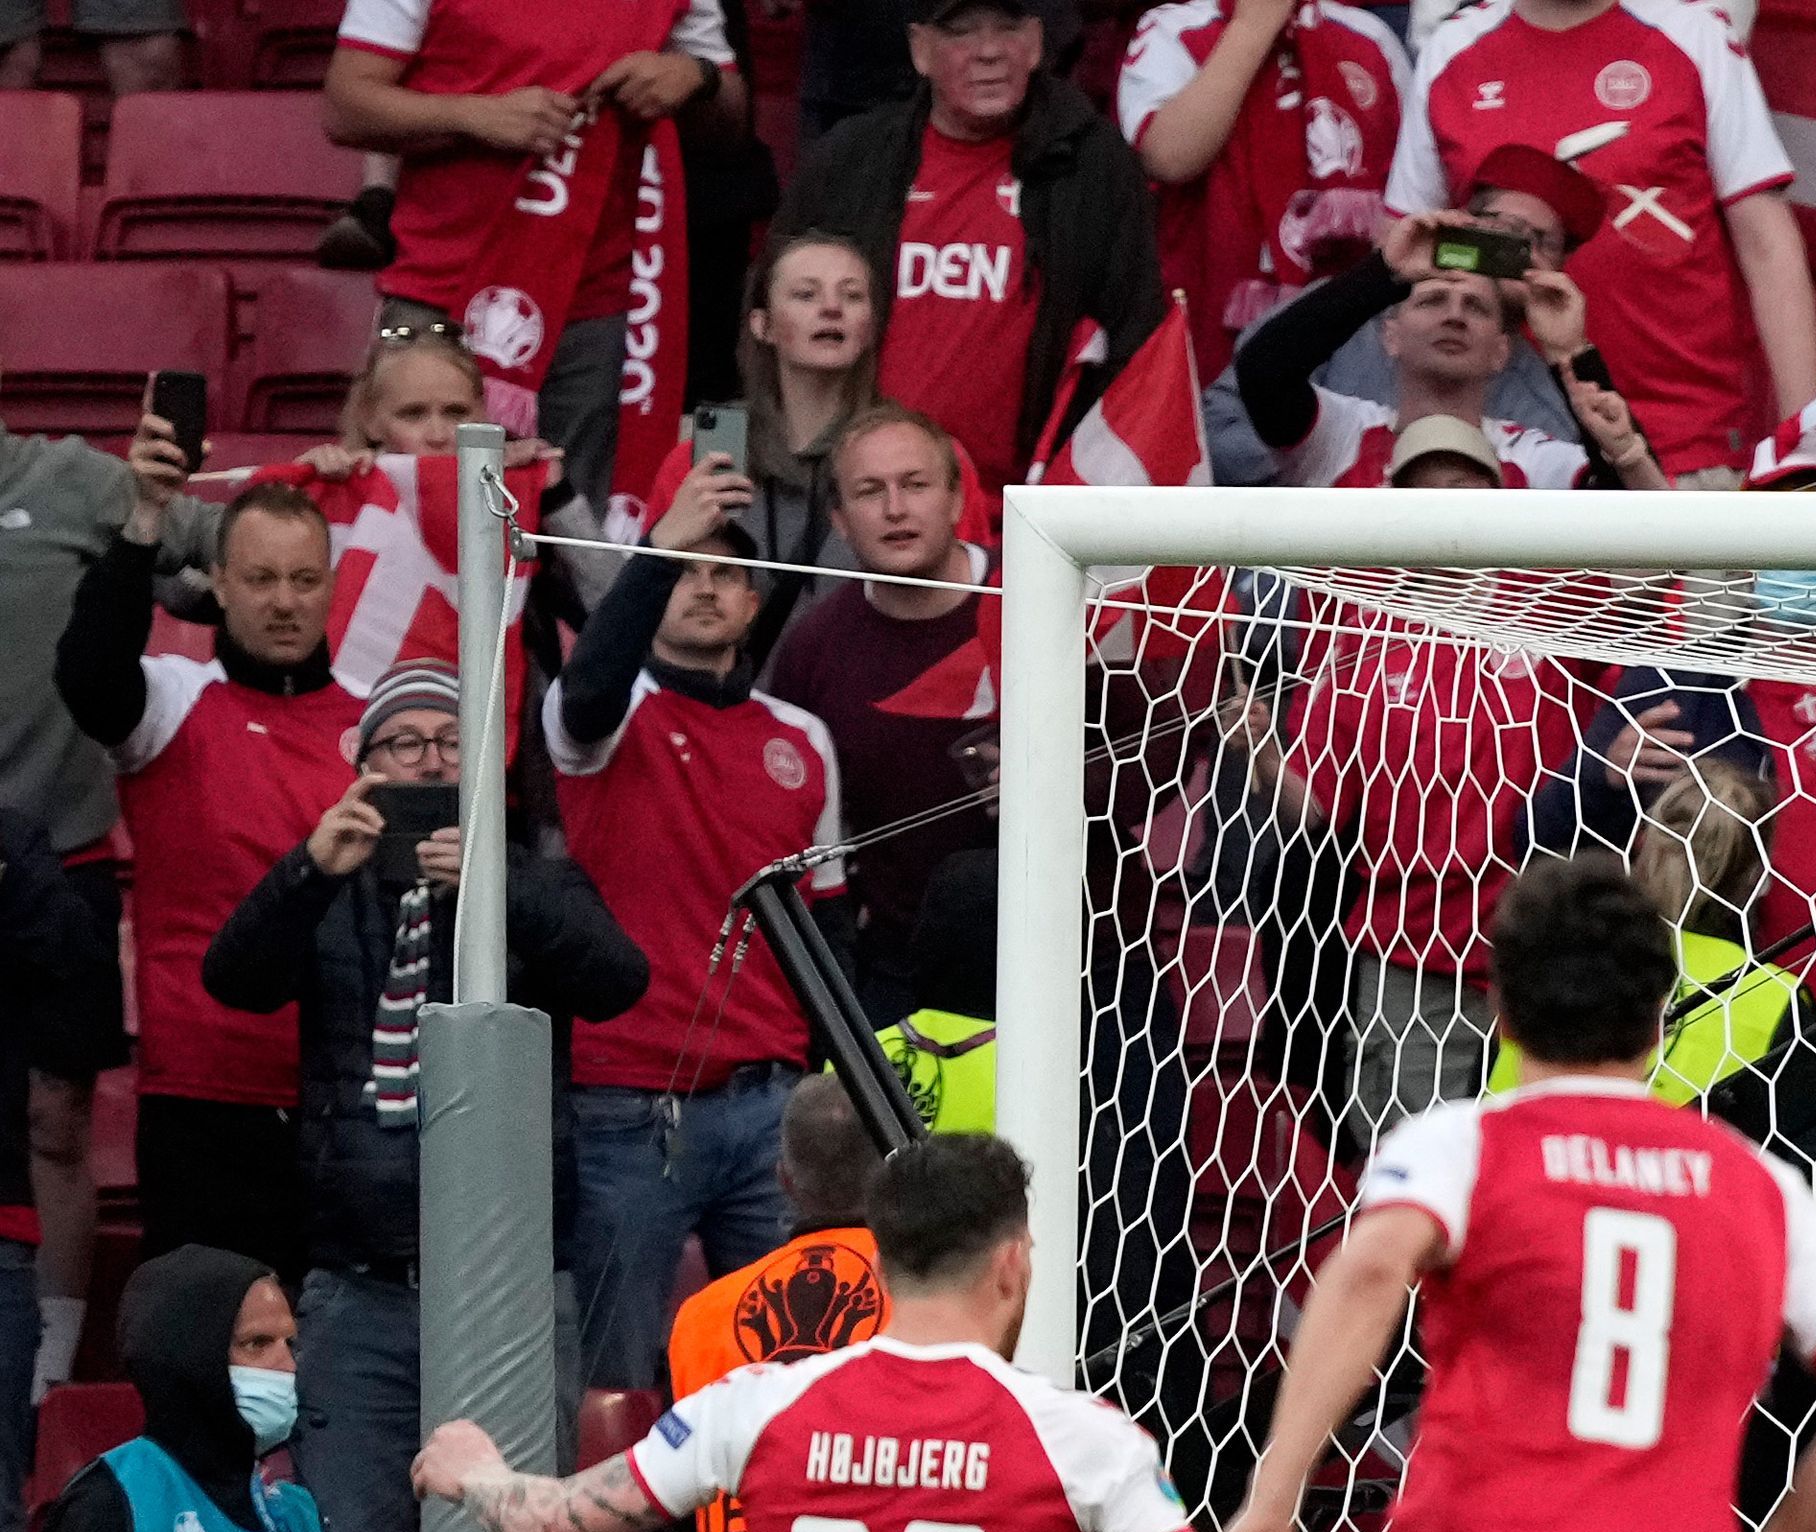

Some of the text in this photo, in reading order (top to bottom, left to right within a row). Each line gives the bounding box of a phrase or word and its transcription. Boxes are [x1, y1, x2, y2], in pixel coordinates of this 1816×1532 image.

[897, 241, 1011, 302] DEN
[1541, 1134, 1712, 1197] DELANEY
[1566, 1206, 1677, 1449] 8
